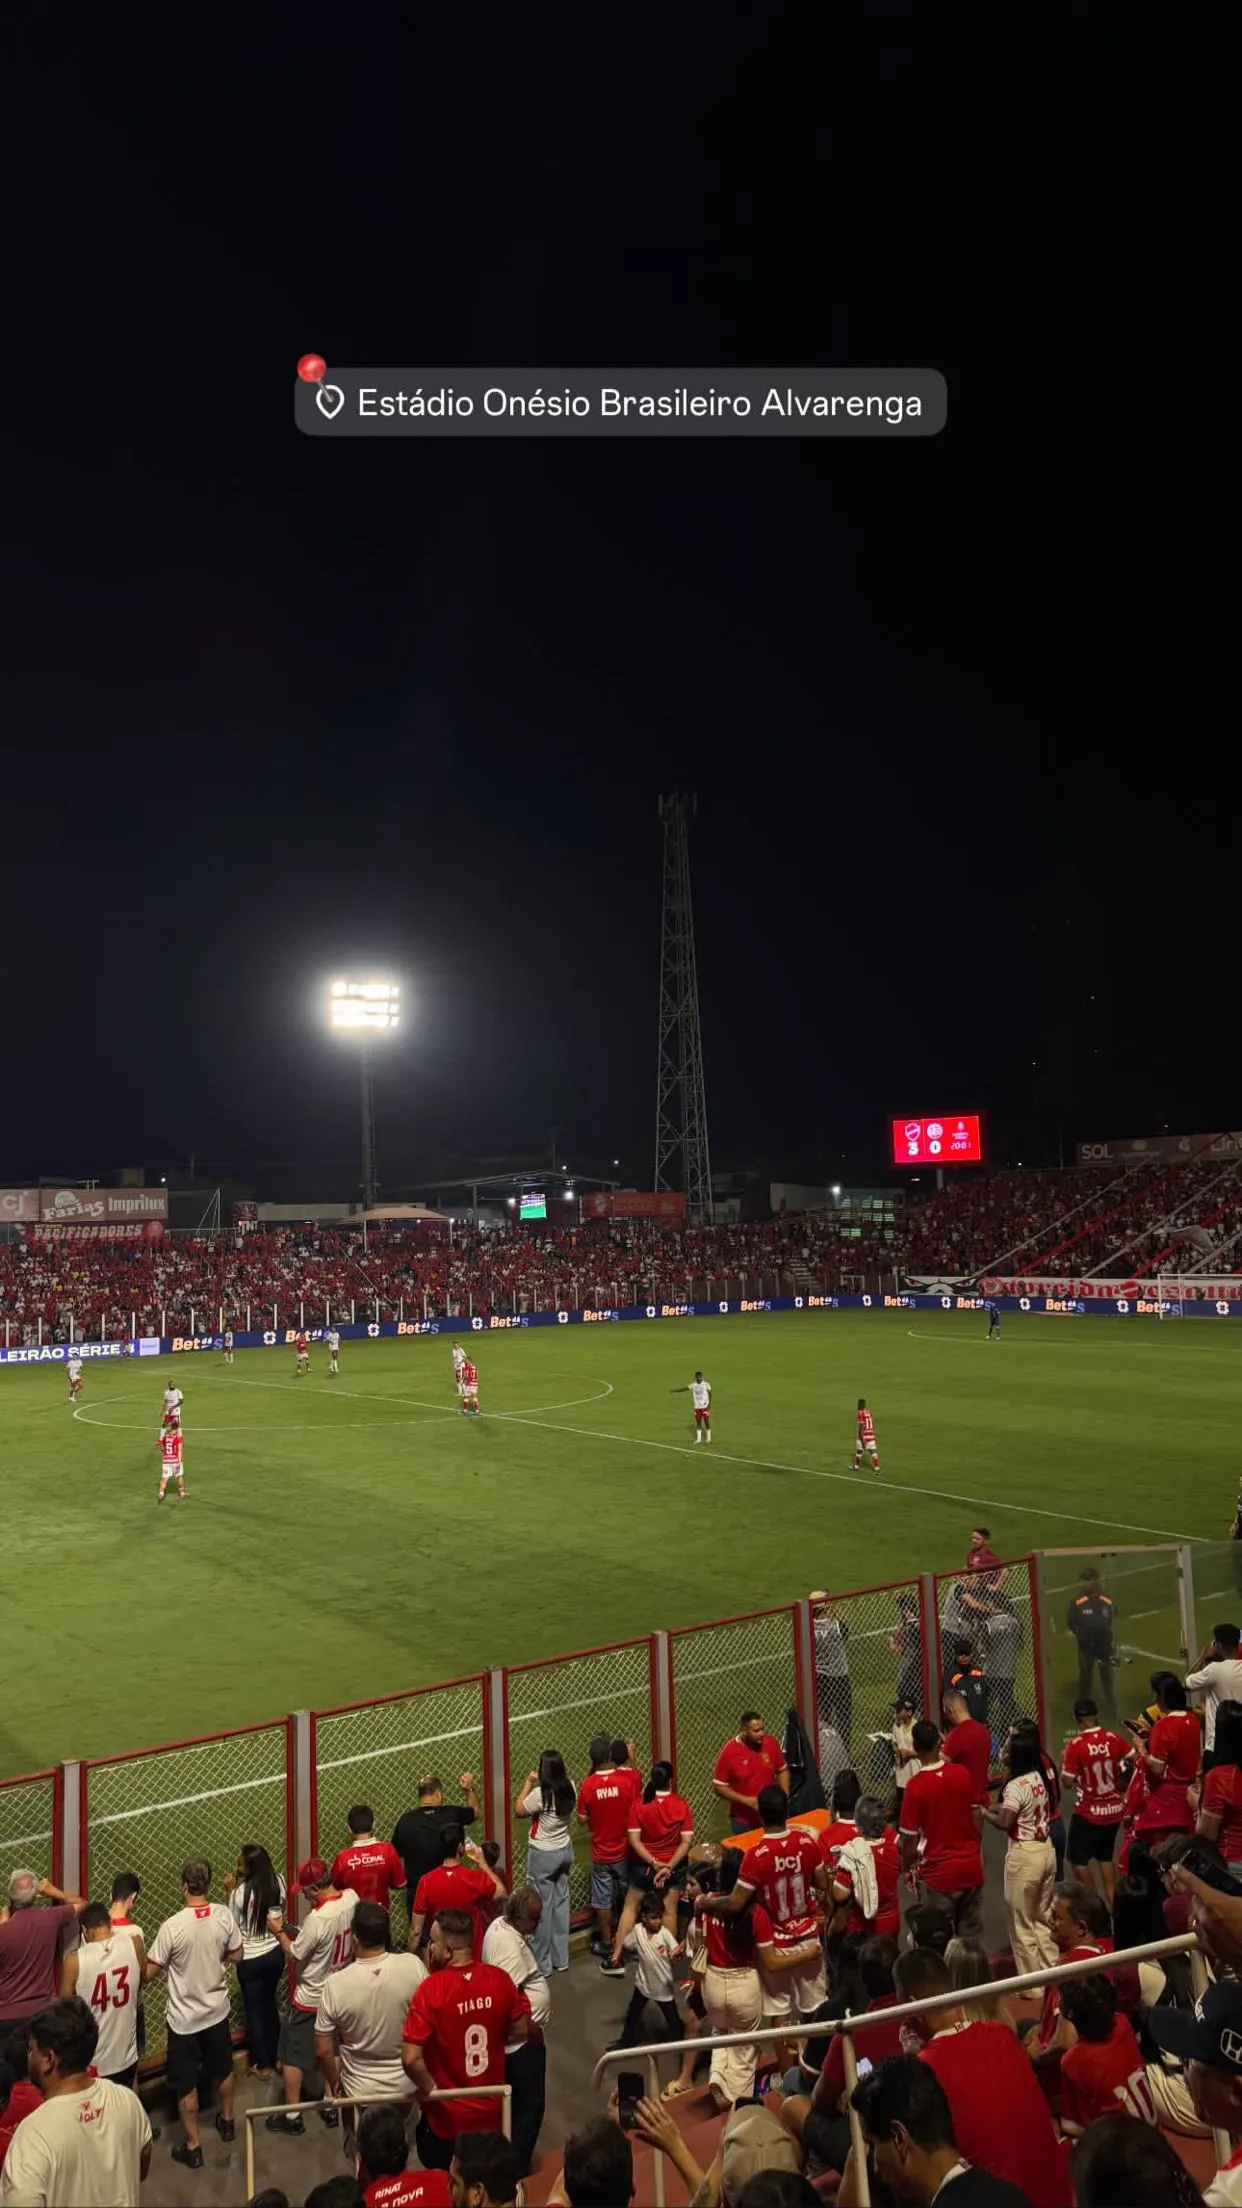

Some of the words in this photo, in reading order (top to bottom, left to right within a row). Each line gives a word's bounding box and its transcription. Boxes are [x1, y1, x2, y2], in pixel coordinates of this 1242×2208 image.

[1081, 1144, 1113, 1160] SOL
[42, 1200, 105, 1221] Farias
[108, 1194, 165, 1214] Imprilux
[1087, 1741, 1110, 1758] bcj
[596, 1786, 618, 1801] RYAN
[774, 1851, 803, 1873] bcj
[775, 1873, 808, 1921] 11
[91, 1965, 130, 2012] 43
[457, 1996, 492, 2015] TIAGO
[464, 2024, 489, 2077] 8
[1113, 2067, 1157, 2126] 10
